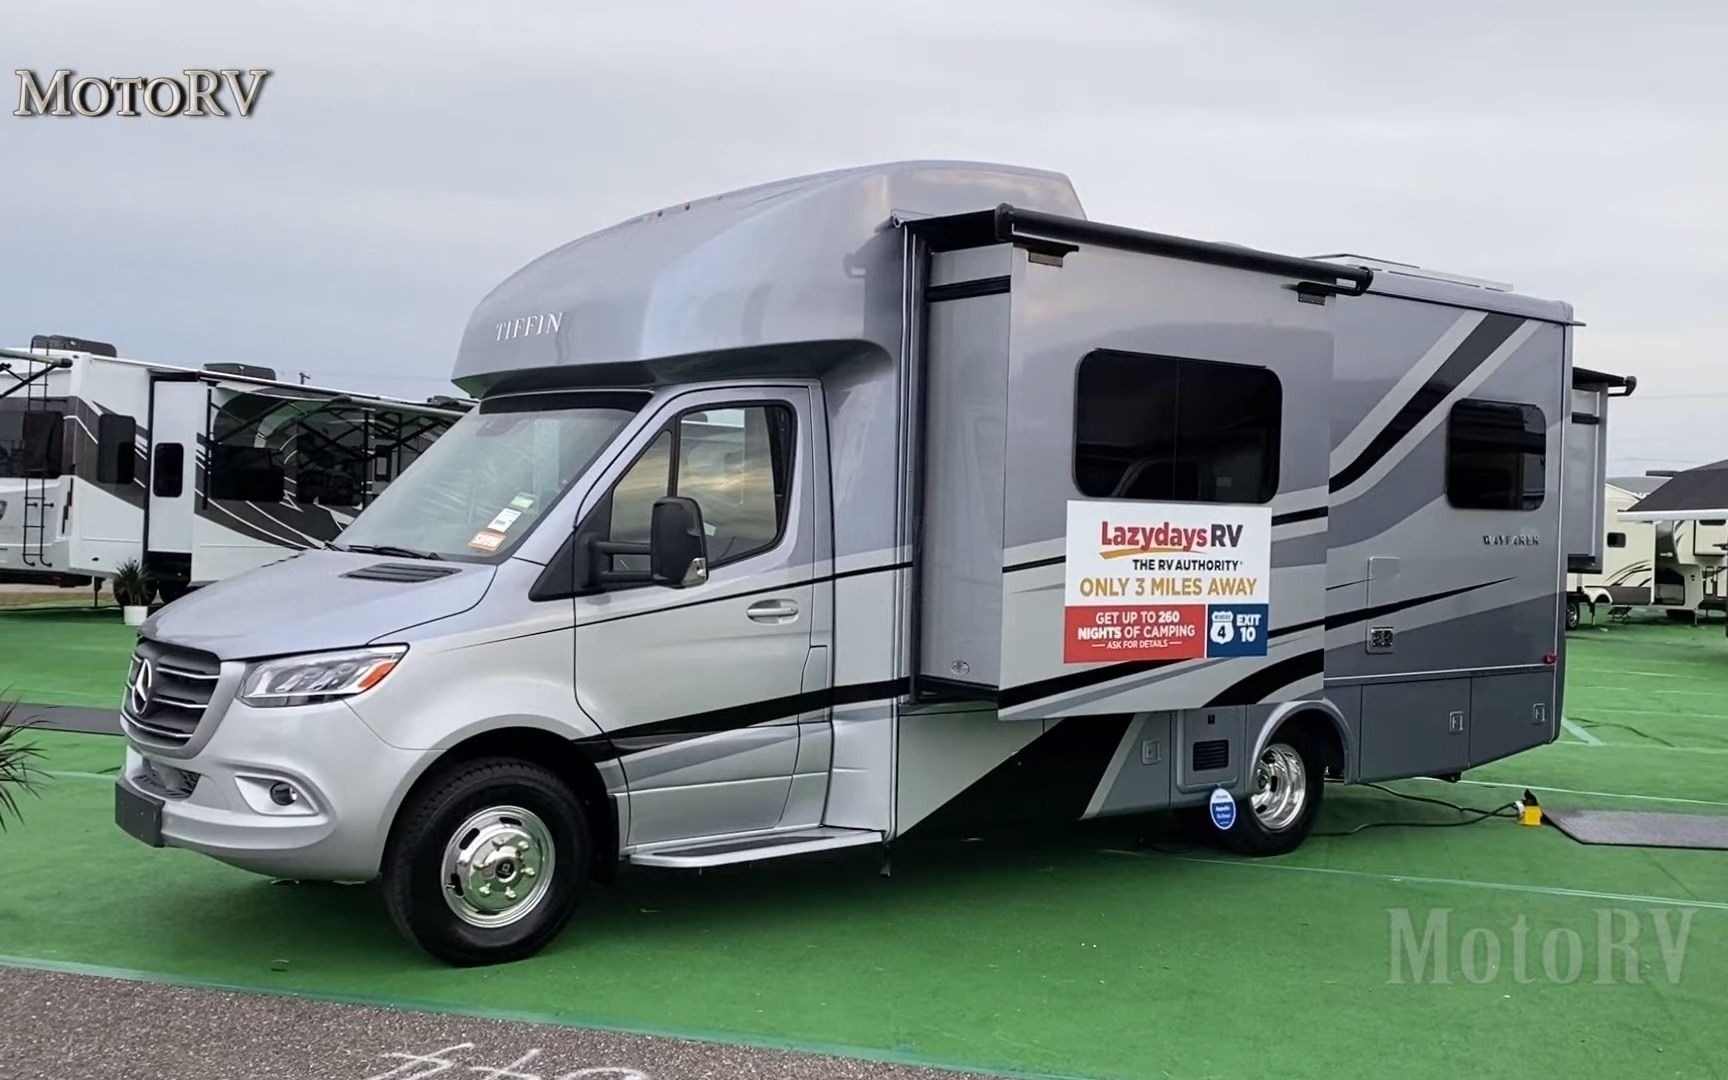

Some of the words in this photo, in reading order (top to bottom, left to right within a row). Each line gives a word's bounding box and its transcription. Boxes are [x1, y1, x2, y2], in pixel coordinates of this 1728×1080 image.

[496, 311, 562, 341] TIFFIN
[1132, 559, 1155, 570] THE
[1158, 559, 1174, 570] RV
[1175, 560, 1239, 571] AUTHORITY
[1080, 577, 1130, 596] ONLY
[1135, 578, 1145, 596] 3
[1151, 578, 1202, 596] MILES
[1207, 578, 1257, 595] AWAY
[1095, 612, 1119, 624] GET
[1122, 611, 1138, 623] UP
[1141, 611, 1156, 623] TO
[1158, 610, 1180, 623] 260
[1236, 614, 1261, 626] EXIT
[1078, 627, 1121, 640] NIGHTS
[1124, 626, 1140, 638] OF
[1143, 625, 1195, 638] CAMPING
[1217, 625, 1226, 638] 4
[1240, 626, 1256, 642] 10
[1107, 641, 1121, 649] ASK
[1123, 640, 1138, 648] FOR
[1139, 639, 1168, 648] DETAILS
